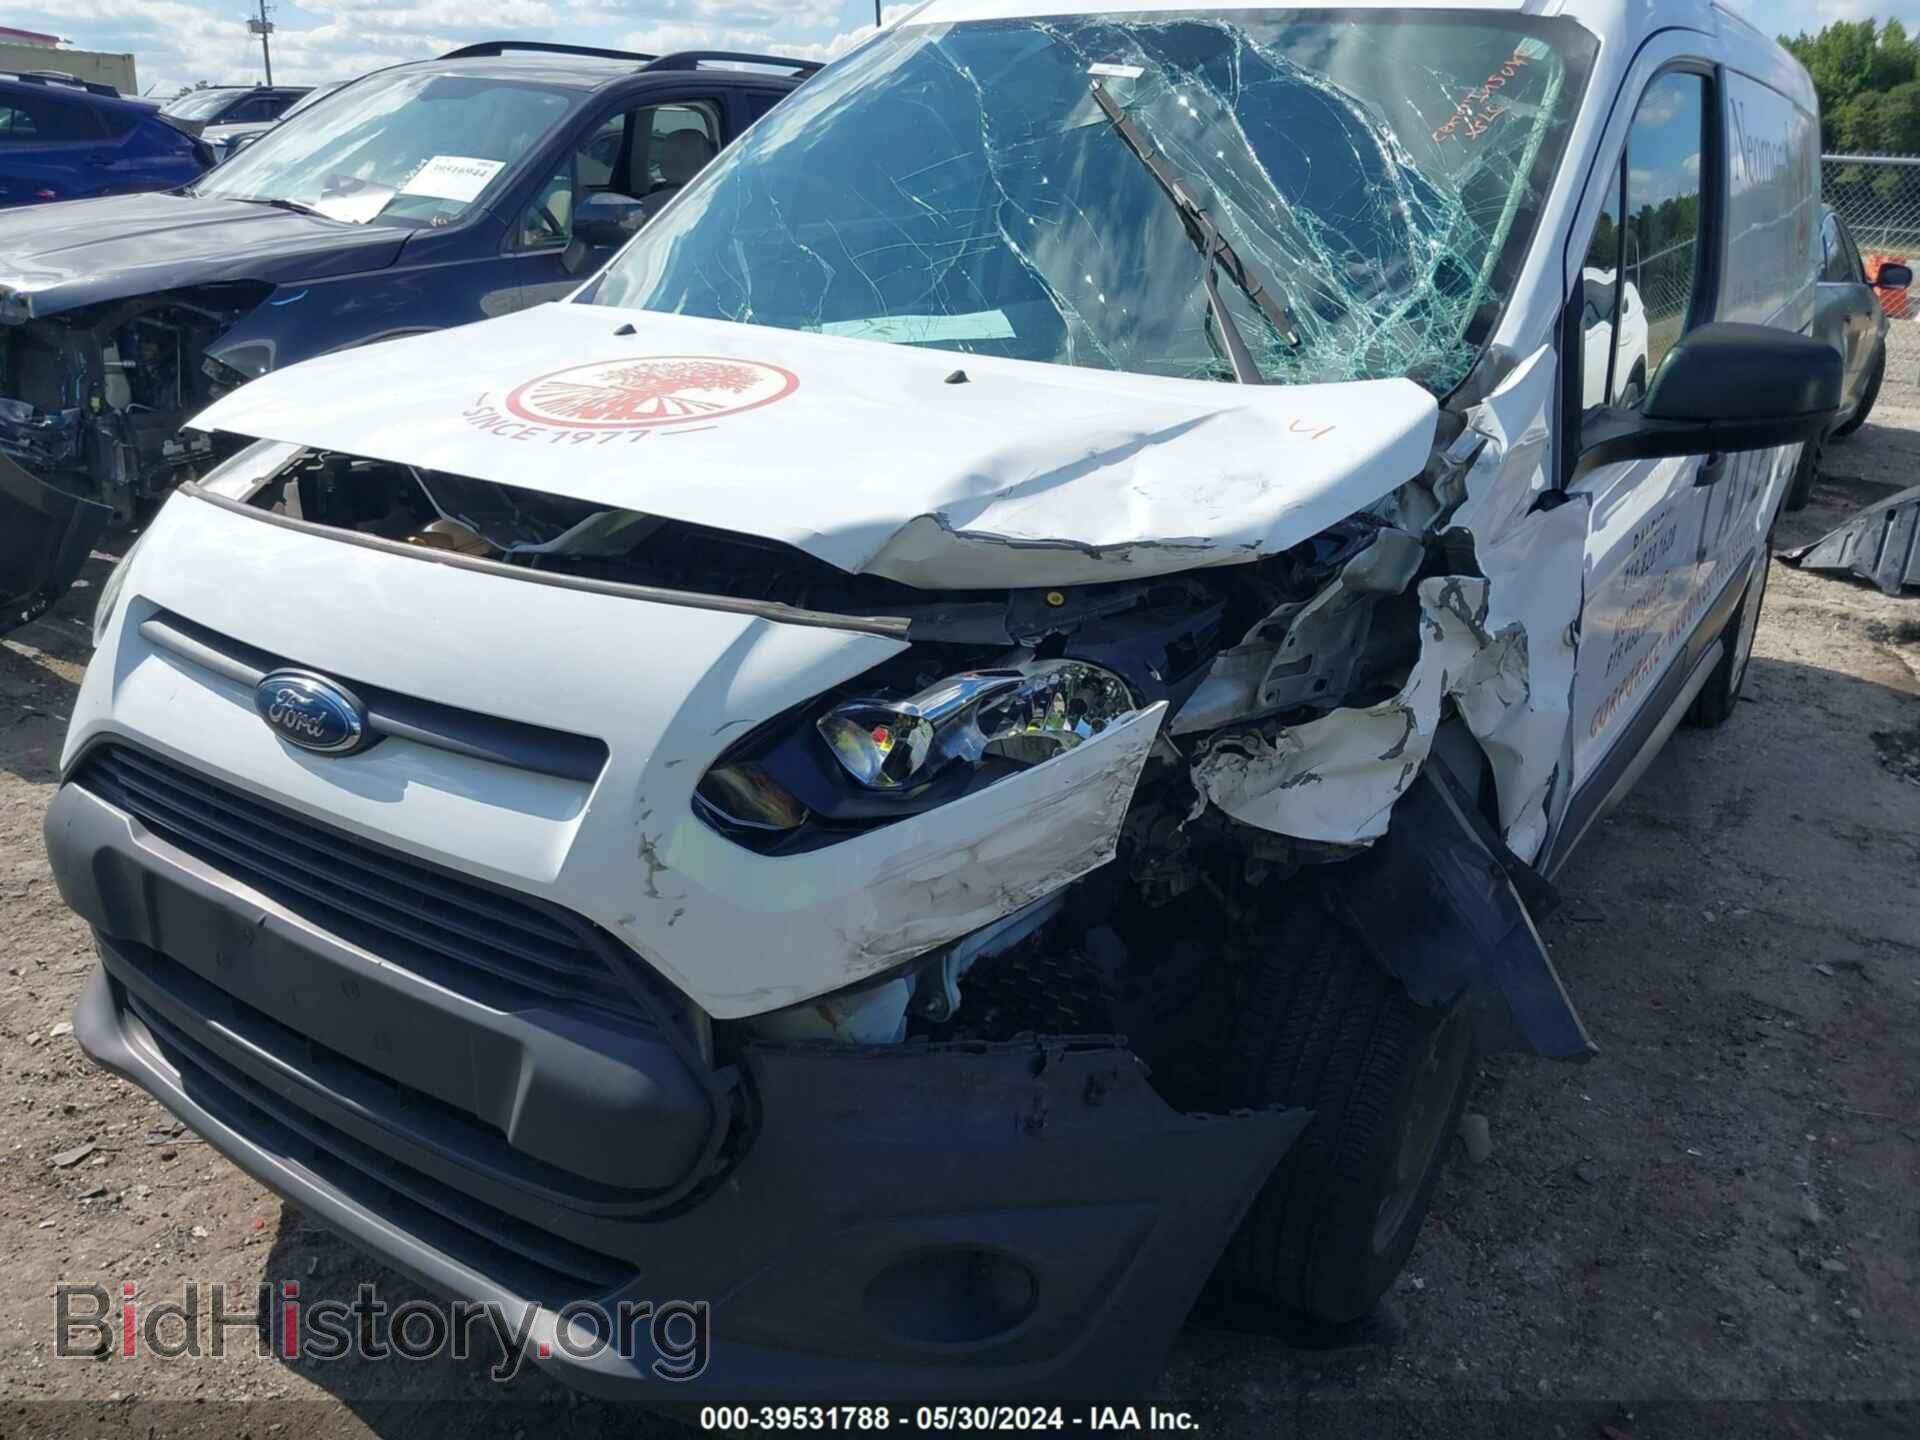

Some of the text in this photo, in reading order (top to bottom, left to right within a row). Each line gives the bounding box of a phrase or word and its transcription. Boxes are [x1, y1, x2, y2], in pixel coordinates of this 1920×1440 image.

[462, 405, 652, 445] SINCE 1977
[268, 688, 328, 737] Ford
